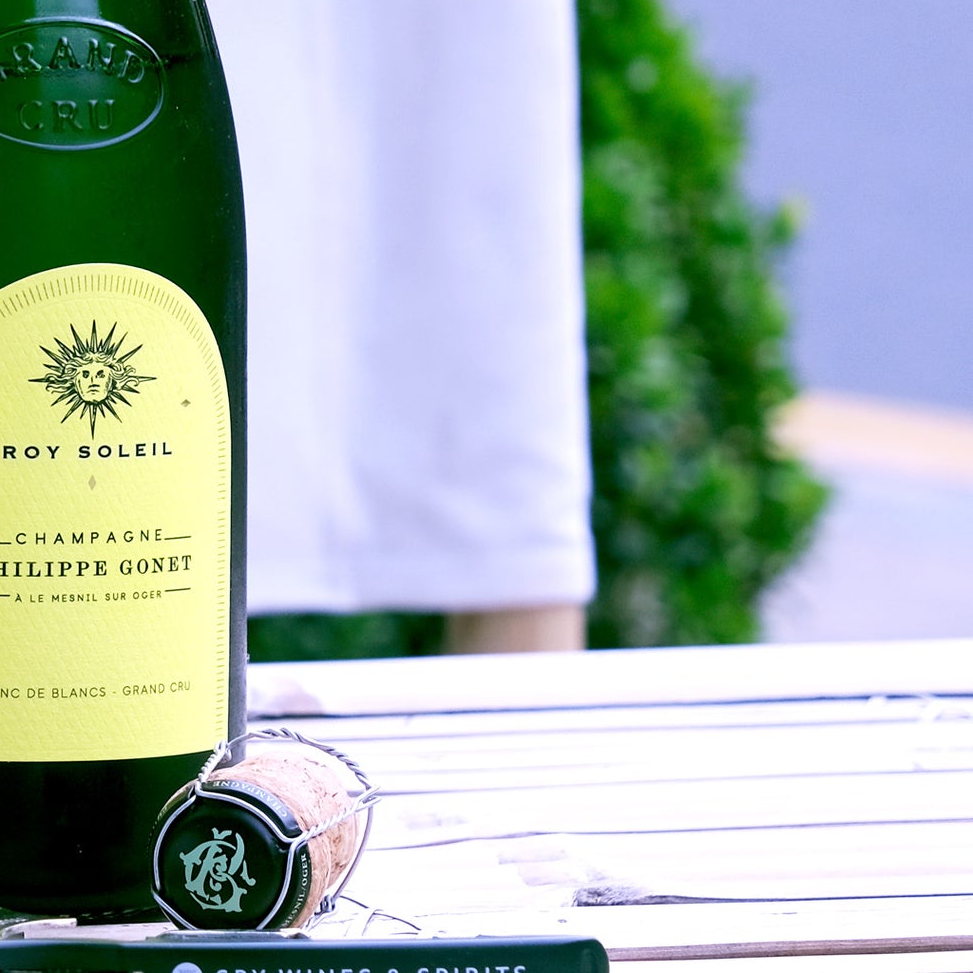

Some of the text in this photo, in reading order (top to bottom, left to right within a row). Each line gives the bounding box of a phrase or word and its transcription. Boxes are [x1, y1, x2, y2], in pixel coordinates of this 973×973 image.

[19, 99, 115, 132] CRU
[2, 442, 173, 459] ROY SOLEIL
[15, 528, 163, 545] CHAMPAGNE
[119, 554, 192, 576] GONET
[29, 594, 44, 603] LE
[51, 593, 98, 602] MESNIL
[105, 592, 127, 602] SUR
[132, 590, 162, 600] OGER
[27, 688, 45, 699] DE
[51, 686, 107, 699] BLANCS
[122, 684, 166, 697] GRAND
[169, 681, 191, 693] CRU
